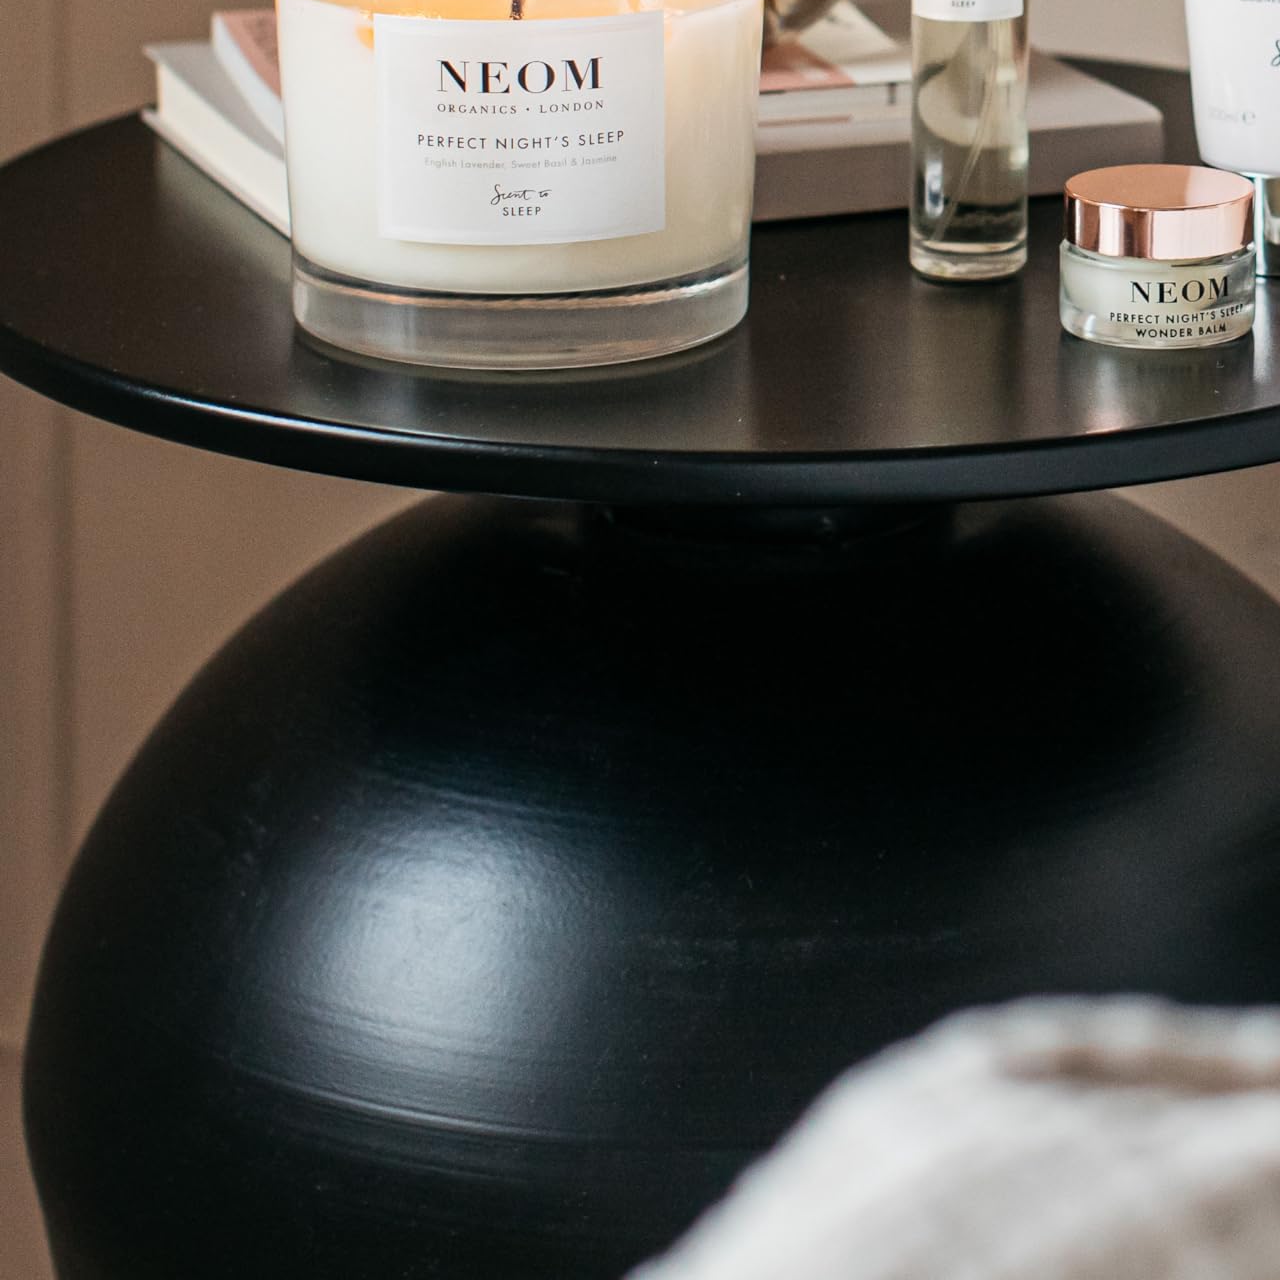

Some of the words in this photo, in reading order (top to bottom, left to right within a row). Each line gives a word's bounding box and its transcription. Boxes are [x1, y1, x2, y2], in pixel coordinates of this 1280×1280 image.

[436, 56, 604, 94] NEOM
[437, 103, 517, 114] ORGANICS
[539, 100, 604, 114] LONDON
[418, 134, 486, 150] PERFECT
[496, 135, 570, 150] NIGHT'S
[578, 130, 625, 146] SLEEP
[424, 157, 457, 169] English
[511, 159, 541, 169] Sweet
[544, 158, 567, 168] Basil
[490, 184, 536, 205] Scent
[502, 206, 542, 217] SLEEP
[1130, 275, 1230, 304] NEOM
[1109, 312, 1160, 324] PERFECT
[1166, 310, 1216, 324] NIGHT'S
[1220, 303, 1244, 318] SLEEP
[1136, 328, 1193, 338] WONDER
[1198, 323, 1227, 336] BALM
